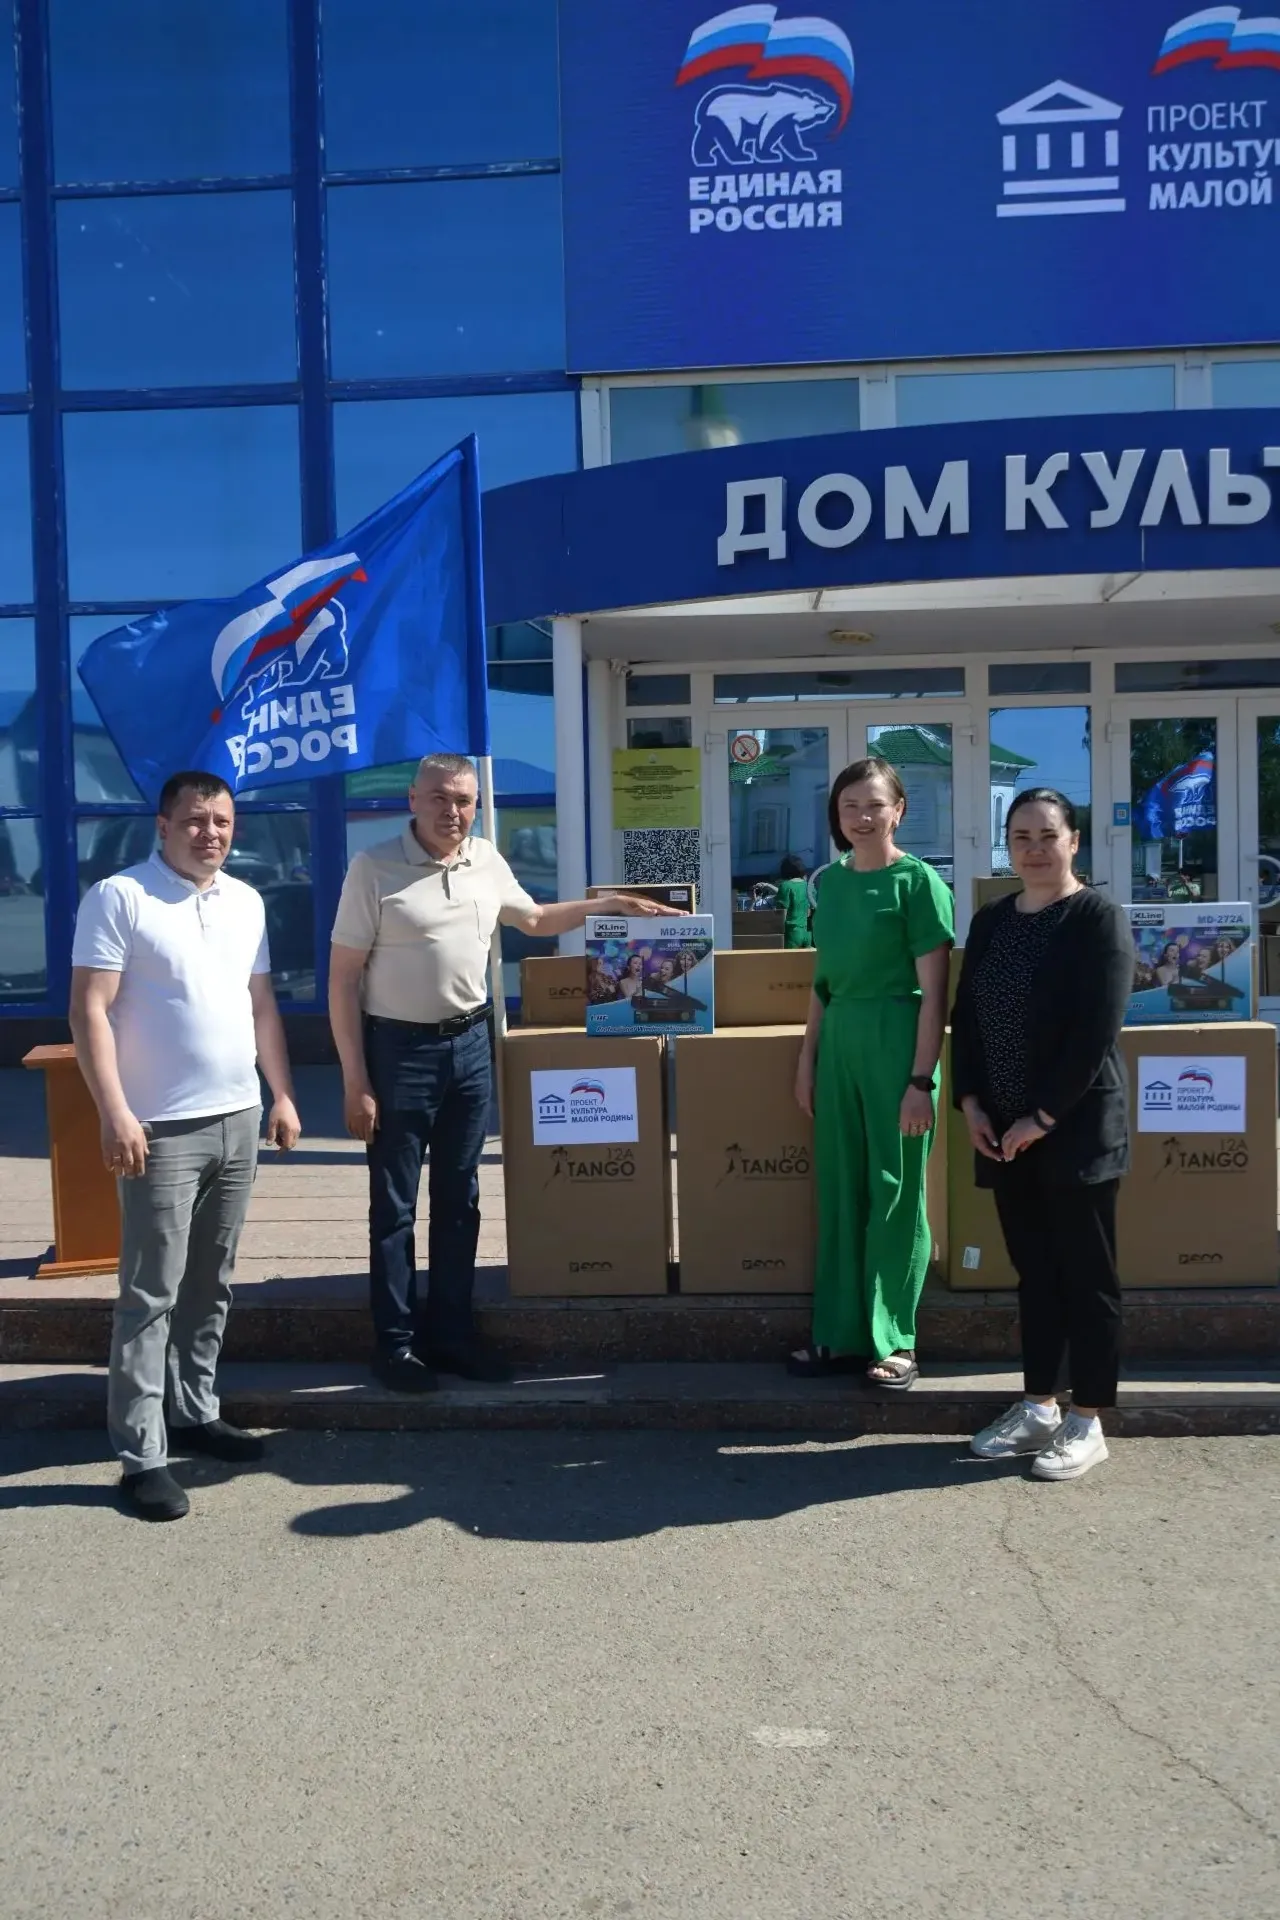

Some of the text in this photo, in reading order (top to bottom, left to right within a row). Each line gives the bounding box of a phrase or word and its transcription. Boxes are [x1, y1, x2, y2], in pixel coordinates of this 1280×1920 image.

[1147, 100, 1268, 133] ПРОЕКТ
[689, 169, 843, 204] ЕДИНАЯ
[1149, 170, 1272, 210] МАЛОЙ
[689, 200, 843, 234] РОССИЯ
[717, 459, 970, 566] ДОМ
[1197, 914, 1244, 924] MD-272A
[597, 921, 625, 931] XLine
[660, 927, 706, 936] MD-272A
[570, 1098, 598, 1106] ПРОЕКТ
[570, 1106, 608, 1115] КУЛЬТУРА
[571, 1114, 634, 1123] МАЛОЙ РОДИНЫ
[1220, 1138, 1248, 1151] 12A
[606, 1147, 635, 1160] 12A
[780, 1145, 808, 1158] 12A
[741, 1158, 810, 1174] TANGO
[1178, 1152, 1249, 1168] TANGO
[567, 1161, 636, 1177] TANGO
